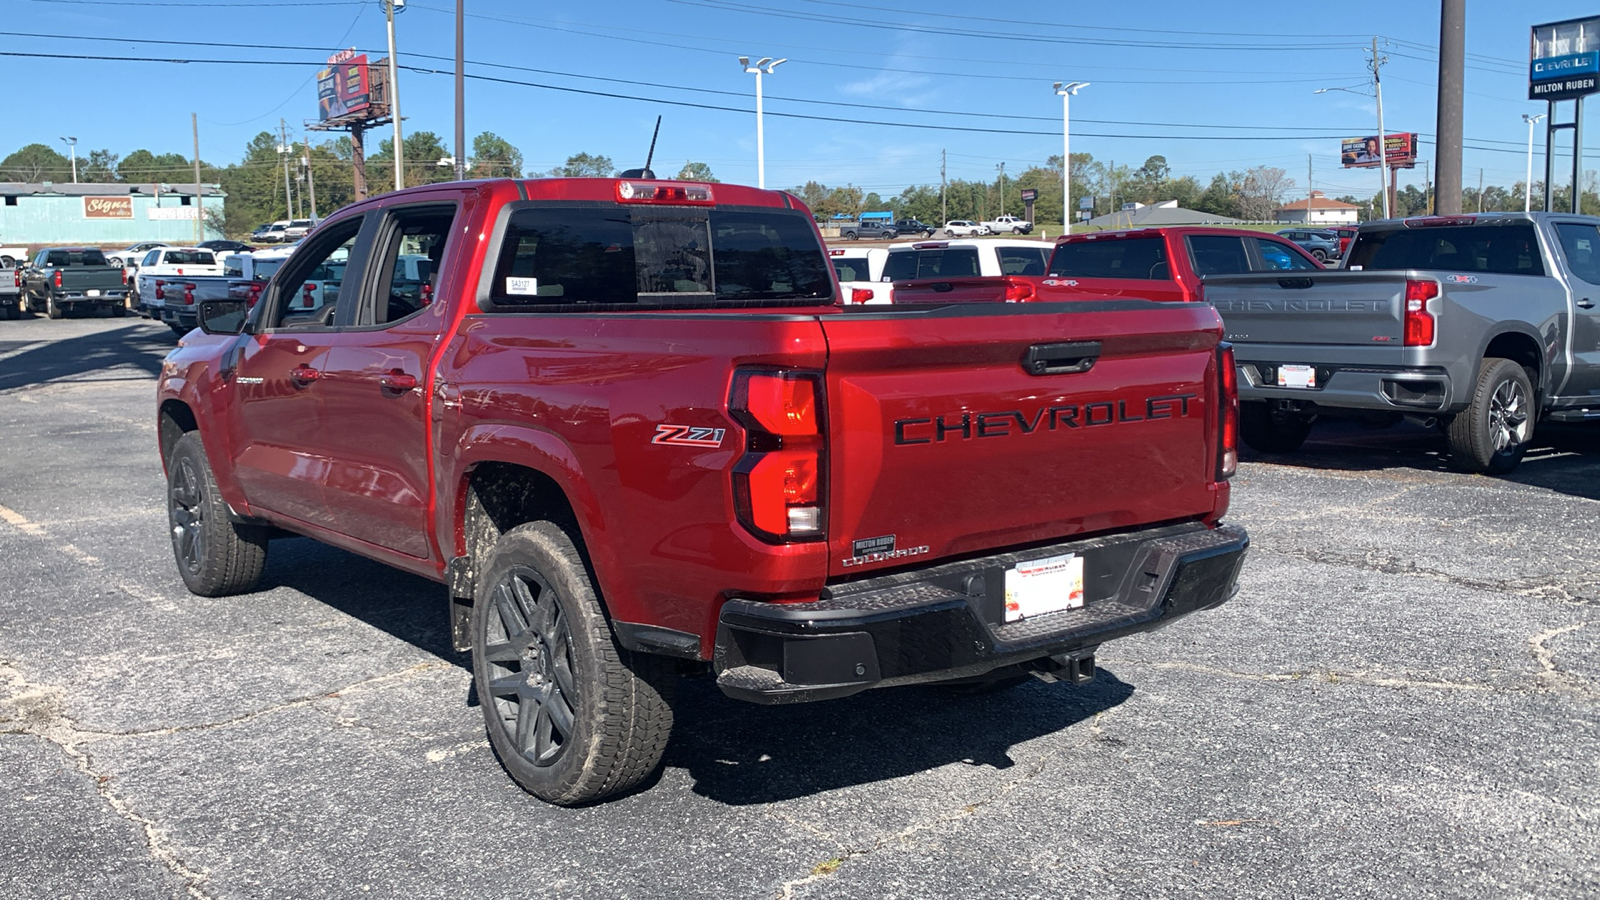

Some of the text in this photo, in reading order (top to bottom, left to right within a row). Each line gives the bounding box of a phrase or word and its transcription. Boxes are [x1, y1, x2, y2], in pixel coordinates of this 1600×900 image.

[1534, 79, 1595, 94] MILTON RUBEN
[87, 199, 128, 212] Signs
[894, 393, 1197, 445] CHEVROLET
[651, 424, 726, 448] Z71
[855, 539, 876, 550] MILTON
[842, 545, 930, 567] COLORADO
